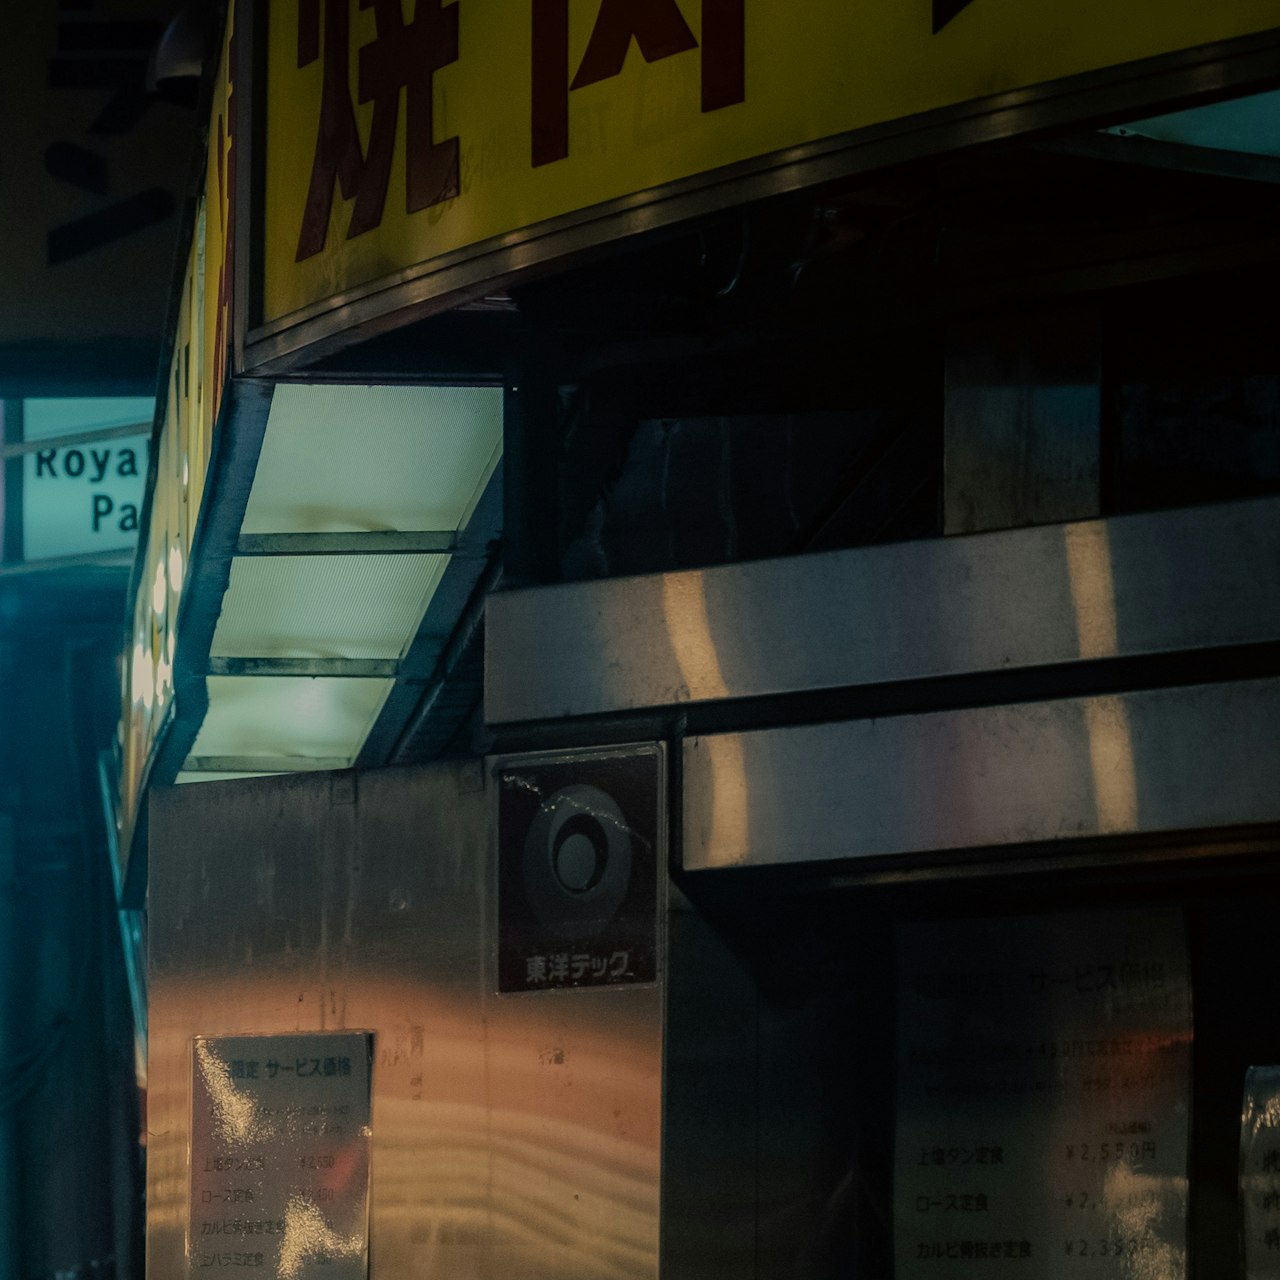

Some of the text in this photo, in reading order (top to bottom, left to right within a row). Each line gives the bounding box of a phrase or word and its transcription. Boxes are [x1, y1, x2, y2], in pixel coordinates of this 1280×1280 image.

[35, 448, 151, 484] Roya
[526, 953, 635, 984] 東洋テック
[266, 1058, 352, 1080] サービス価格
[917, 1146, 1005, 1166] 上塩タン定食
[916, 1194, 989, 1212] ロース定食
[917, 1239, 1032, 1260] カルビ骨抜き定食
